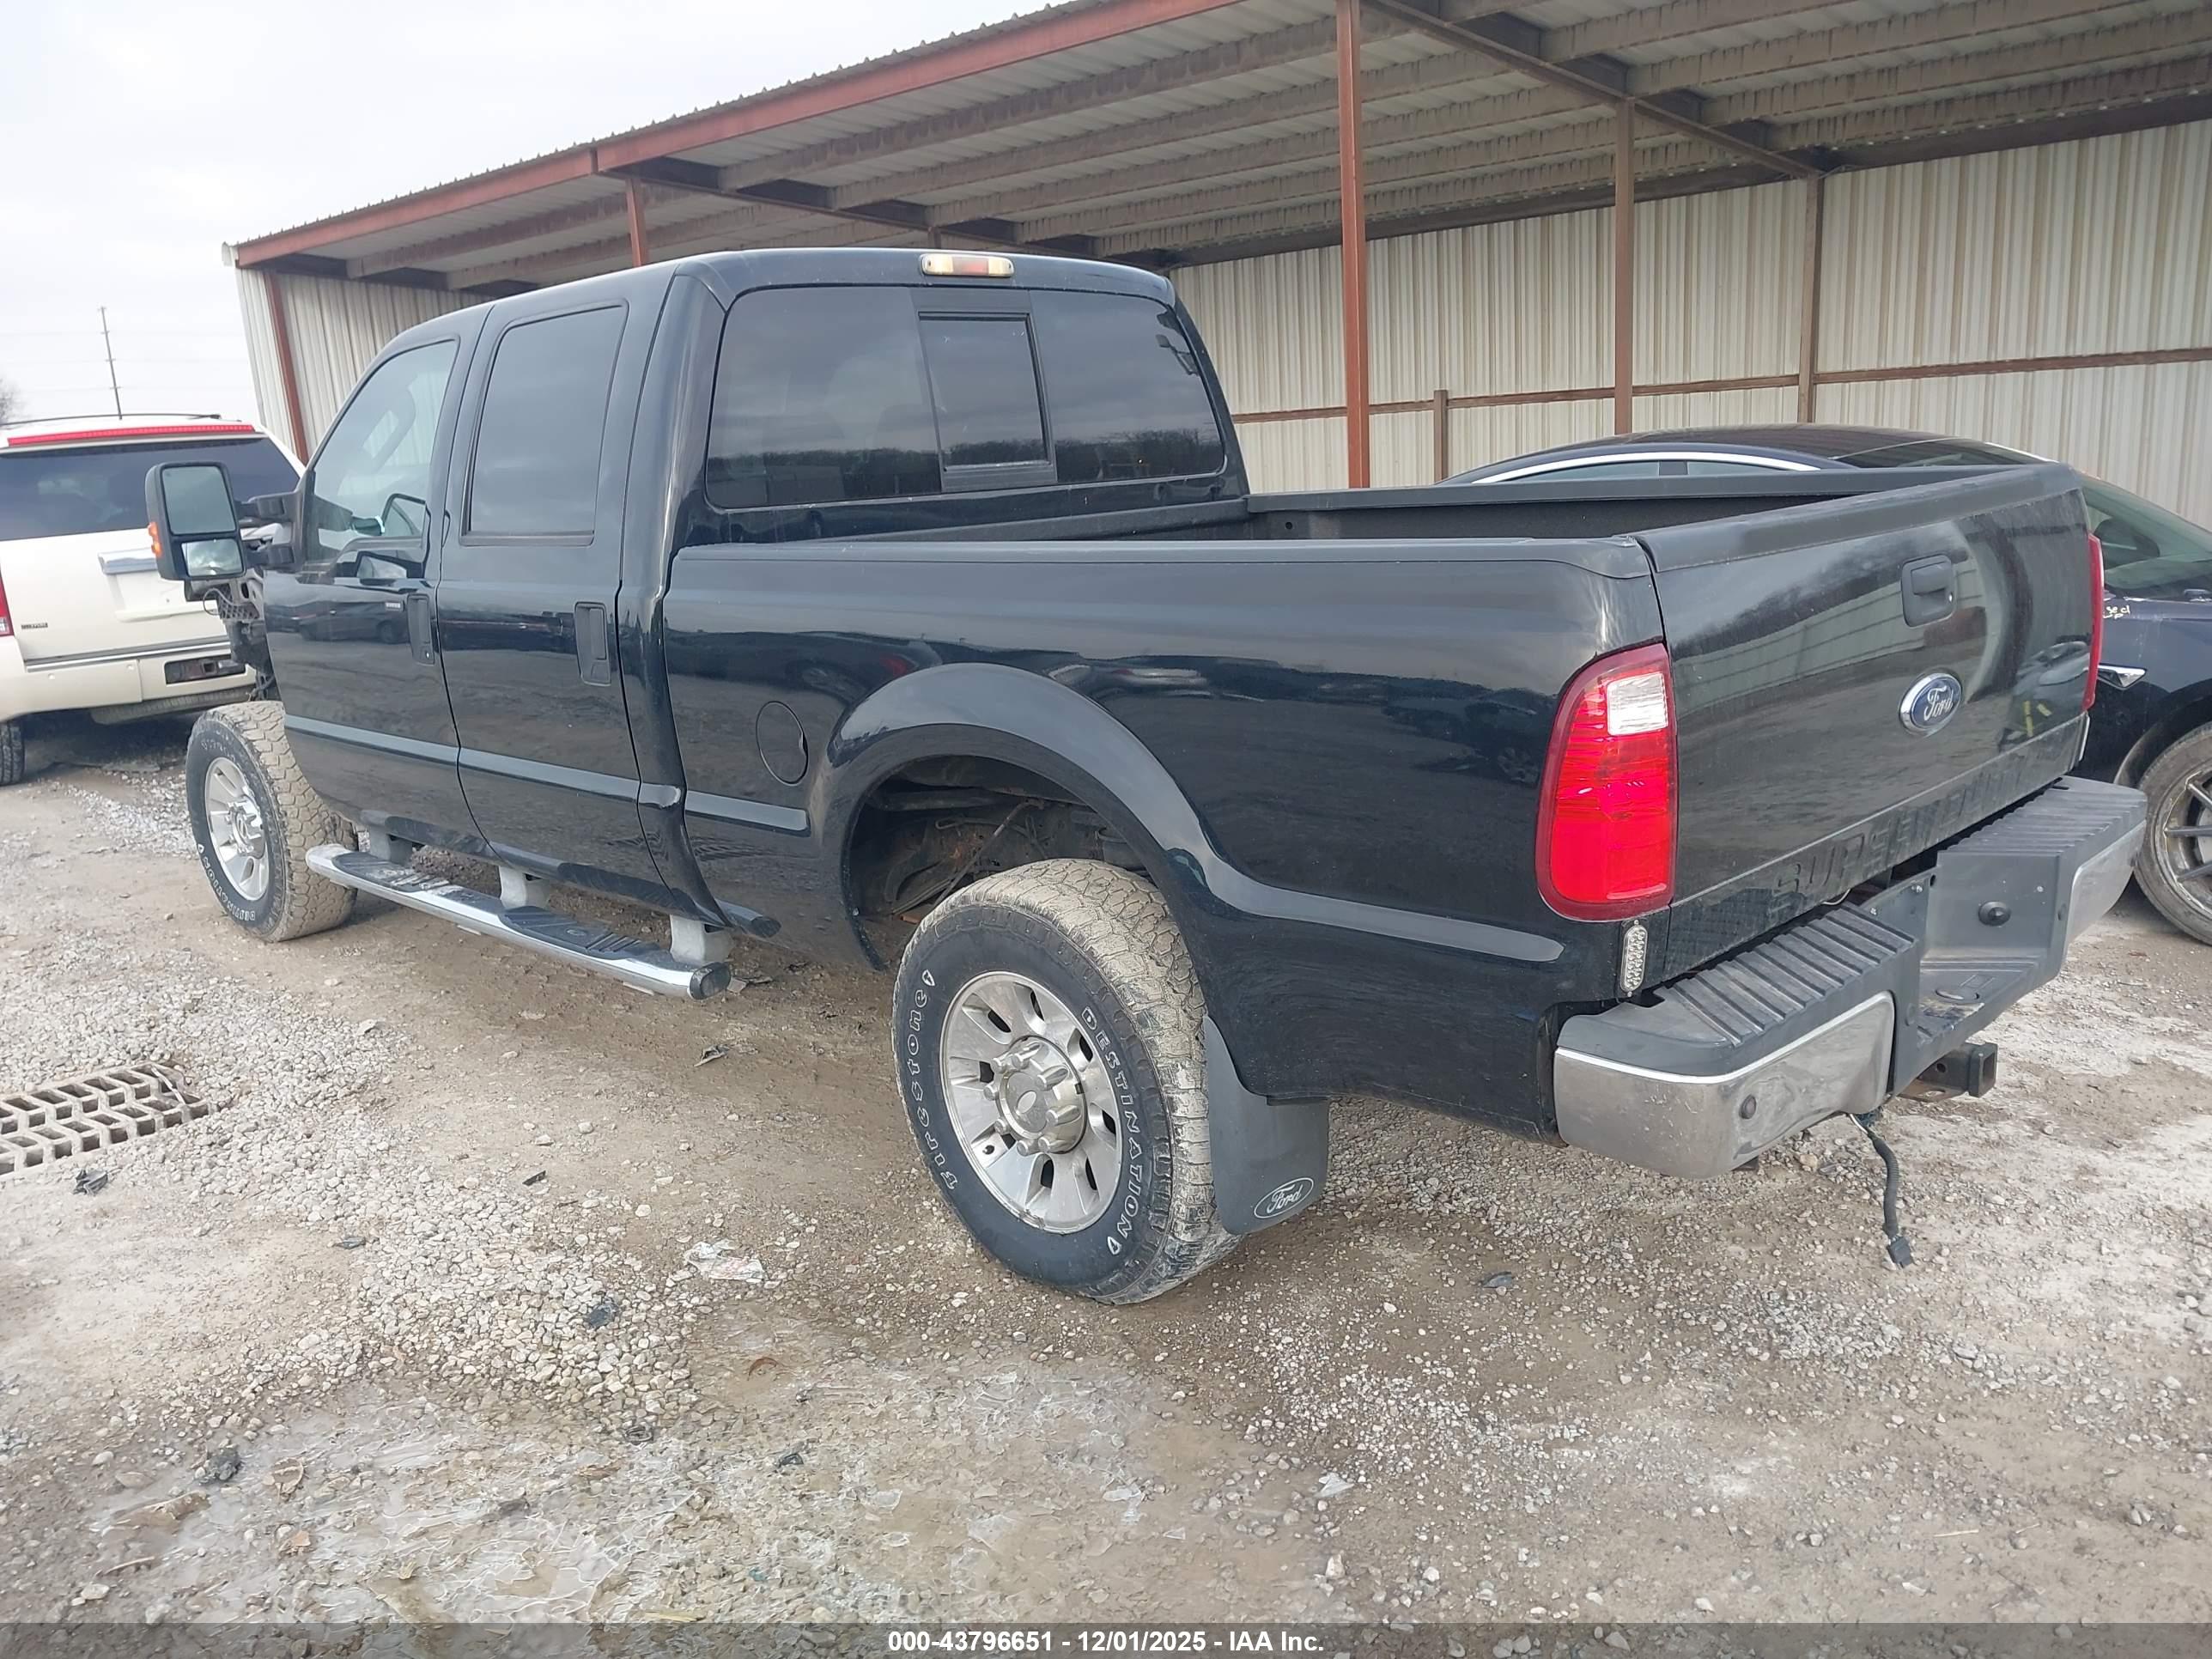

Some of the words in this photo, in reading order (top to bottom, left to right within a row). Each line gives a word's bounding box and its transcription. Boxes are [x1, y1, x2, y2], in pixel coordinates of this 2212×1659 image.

[1923, 684, 1954, 722] Ford
[906, 988, 958, 1190] Firestone
[1080, 1006, 1142, 1239] DESTINATION
[1266, 1183, 1304, 1214] Ford
